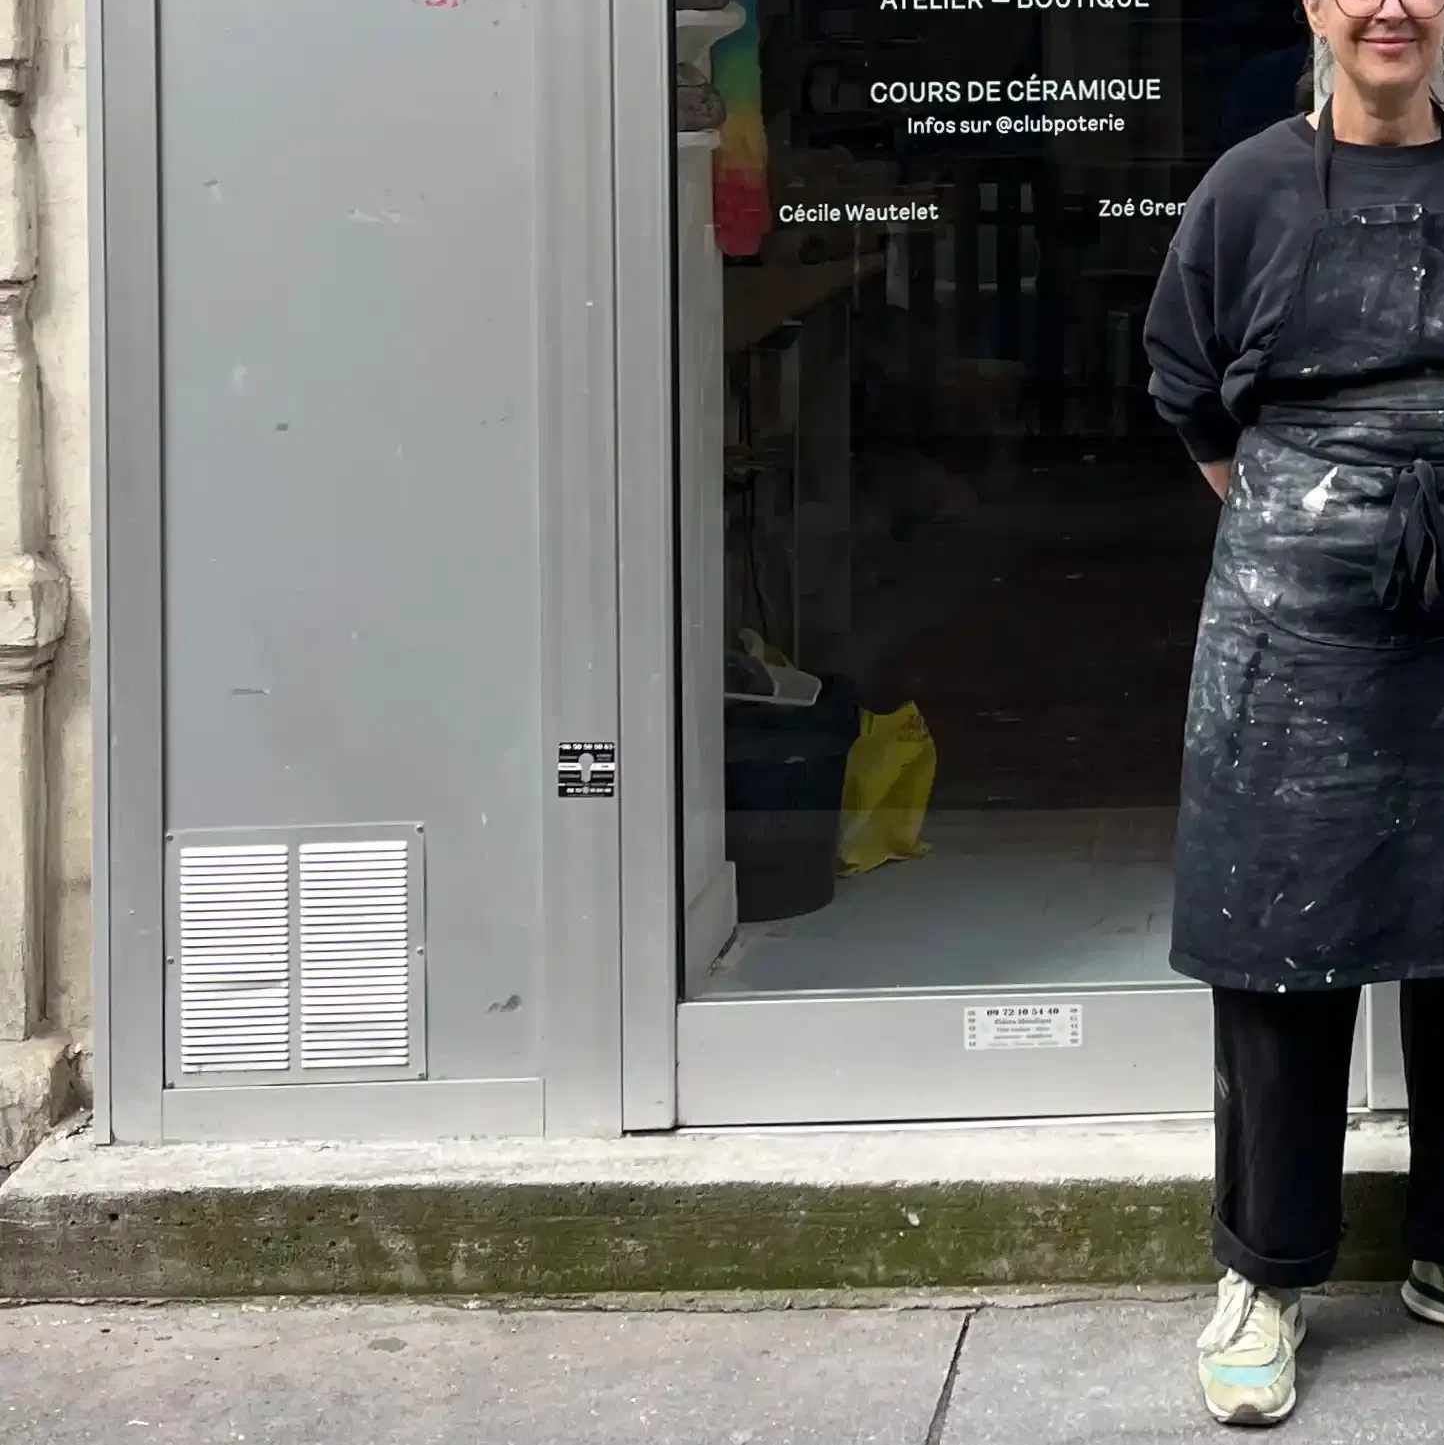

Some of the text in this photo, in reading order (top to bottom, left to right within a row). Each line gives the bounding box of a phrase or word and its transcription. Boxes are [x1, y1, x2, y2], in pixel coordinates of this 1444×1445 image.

[870, 74, 1161, 103] COURS DE CÉRAMIQUE
[908, 114, 1125, 136] Infos sur @clubpoterie
[779, 202, 939, 223] Cécile Wautelet
[1099, 197, 1134, 217] Zoé
